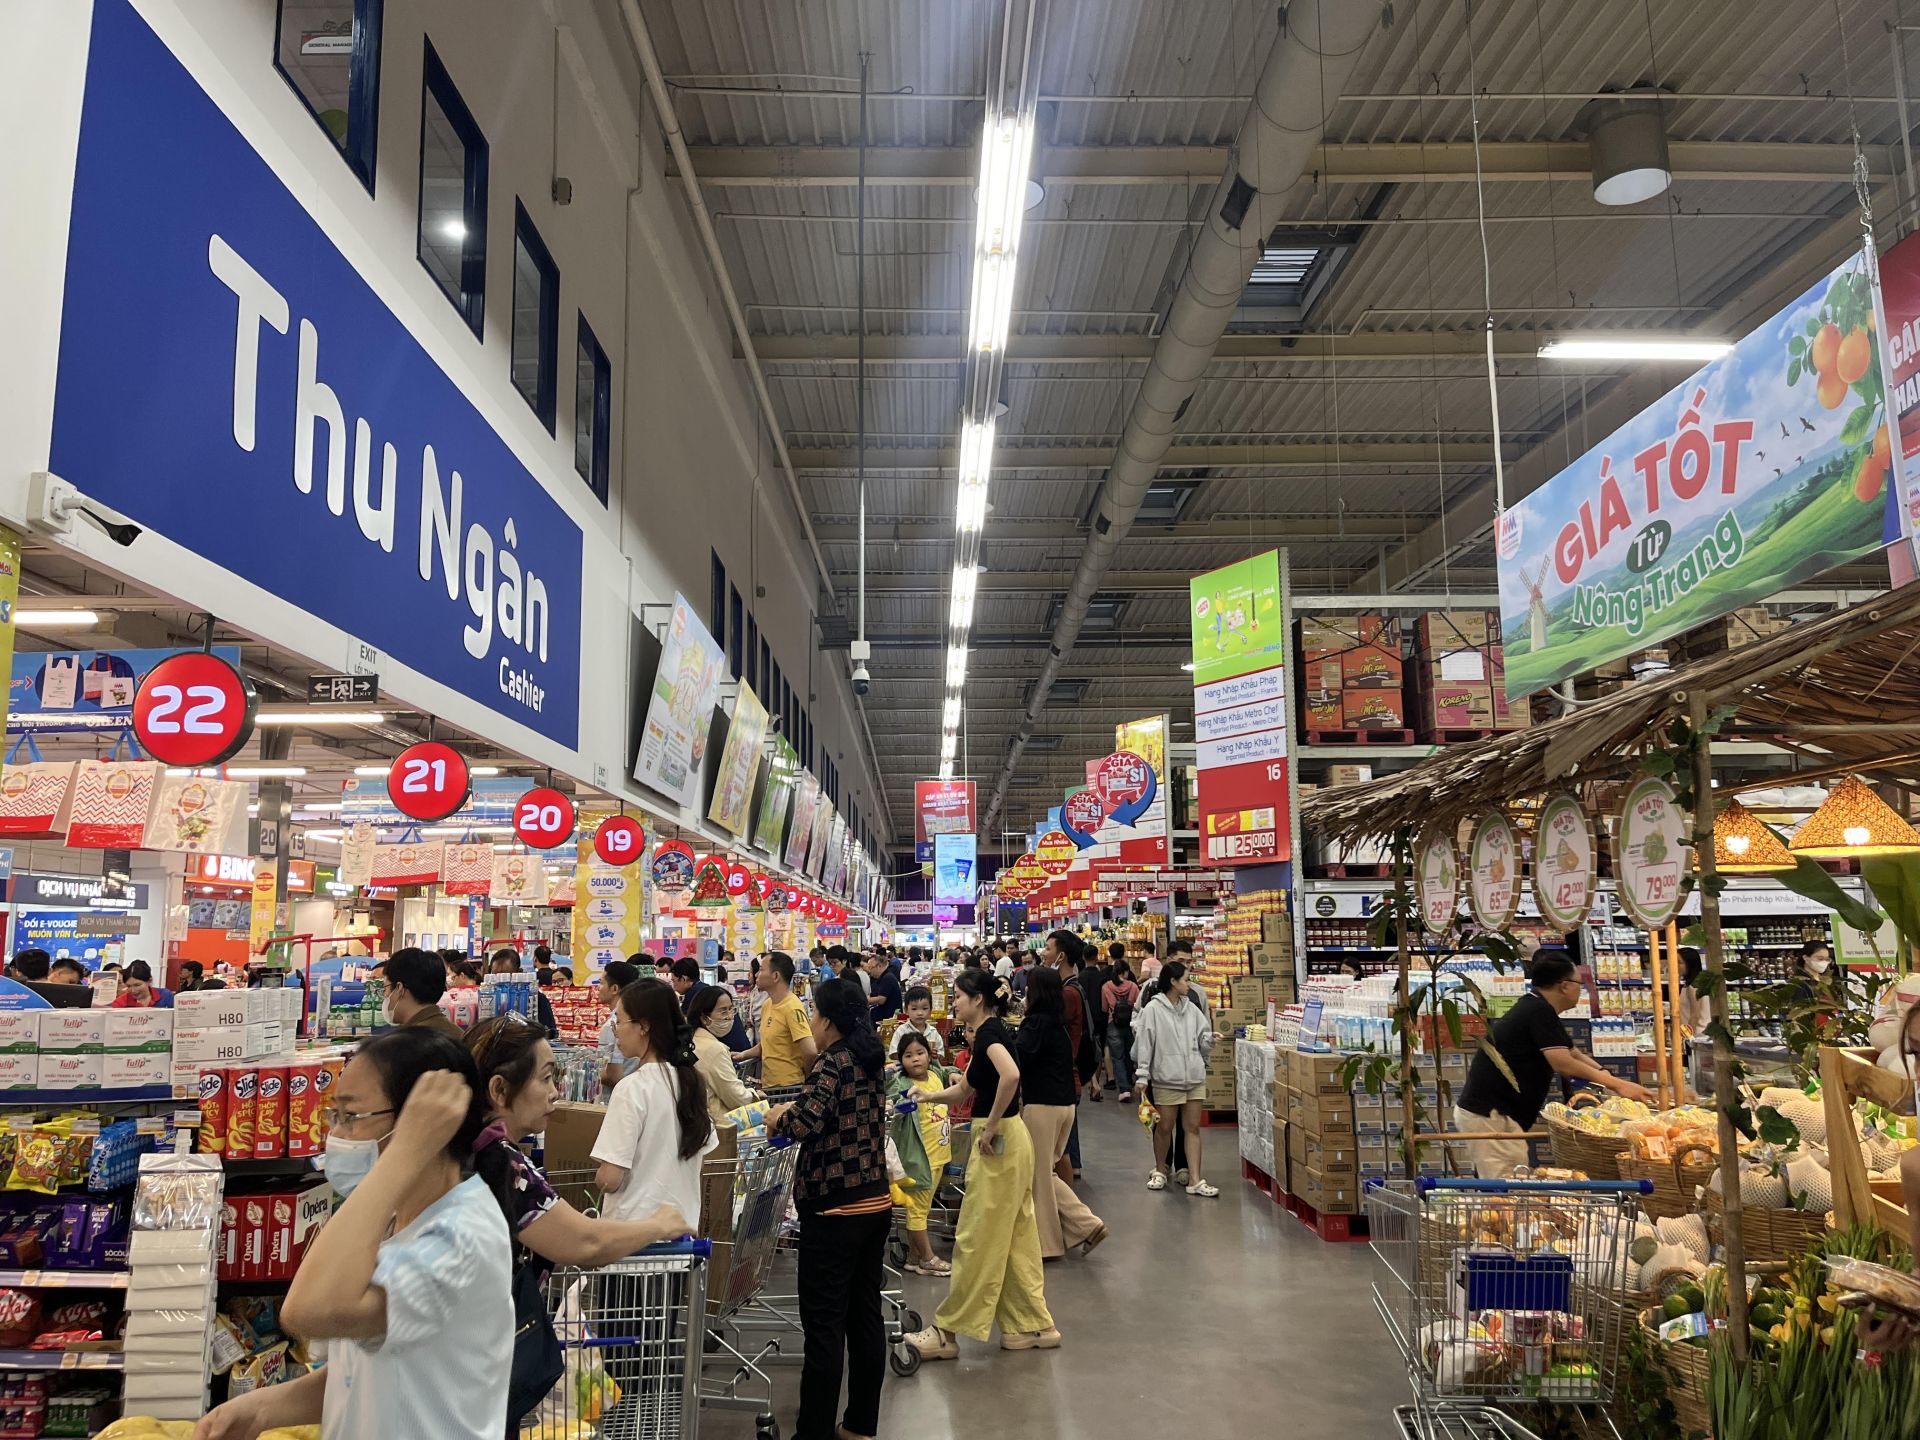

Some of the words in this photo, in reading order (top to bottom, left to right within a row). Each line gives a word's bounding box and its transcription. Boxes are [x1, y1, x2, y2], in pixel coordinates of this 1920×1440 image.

[208, 233, 397, 553] Thu
[418, 443, 549, 663] Ngân
[1554, 456, 1632, 585] GIÁ
[1633, 386, 1754, 515] TỐT
[1573, 583, 1645, 636] Nông
[1645, 510, 1745, 612] Trang
[360, 644, 377, 665] EXIT
[499, 656, 546, 713] Cashier
[147, 684, 226, 735] 22
[1244, 709, 1262, 718] Metro
[1263, 703, 1279, 715] Chef
[1439, 693, 1473, 709] KORENO
[402, 758, 446, 793] 21
[1266, 763, 1281, 781] 16
[519, 803, 562, 832] 20
[261, 828, 276, 847] 20
[290, 832, 304, 851] 19
[605, 829, 632, 852] 19
[1156, 839, 1164, 850] 15
[39, 879, 63, 898] DỊCH
[64, 881, 80, 899] VỤ
[80, 881, 103, 897] KHÁ
[591, 878, 620, 887] 50.000
[40, 919, 77, 928] E-VOUCHE
[218, 1012, 244, 1025] H80
[217, 1045, 243, 1058] H80
[261, 1080, 280, 1095] Slide
[303, 1198, 328, 1222] Opéra
[244, 1232, 253, 1262] Opéra
[271, 1231, 280, 1261] Opéra
